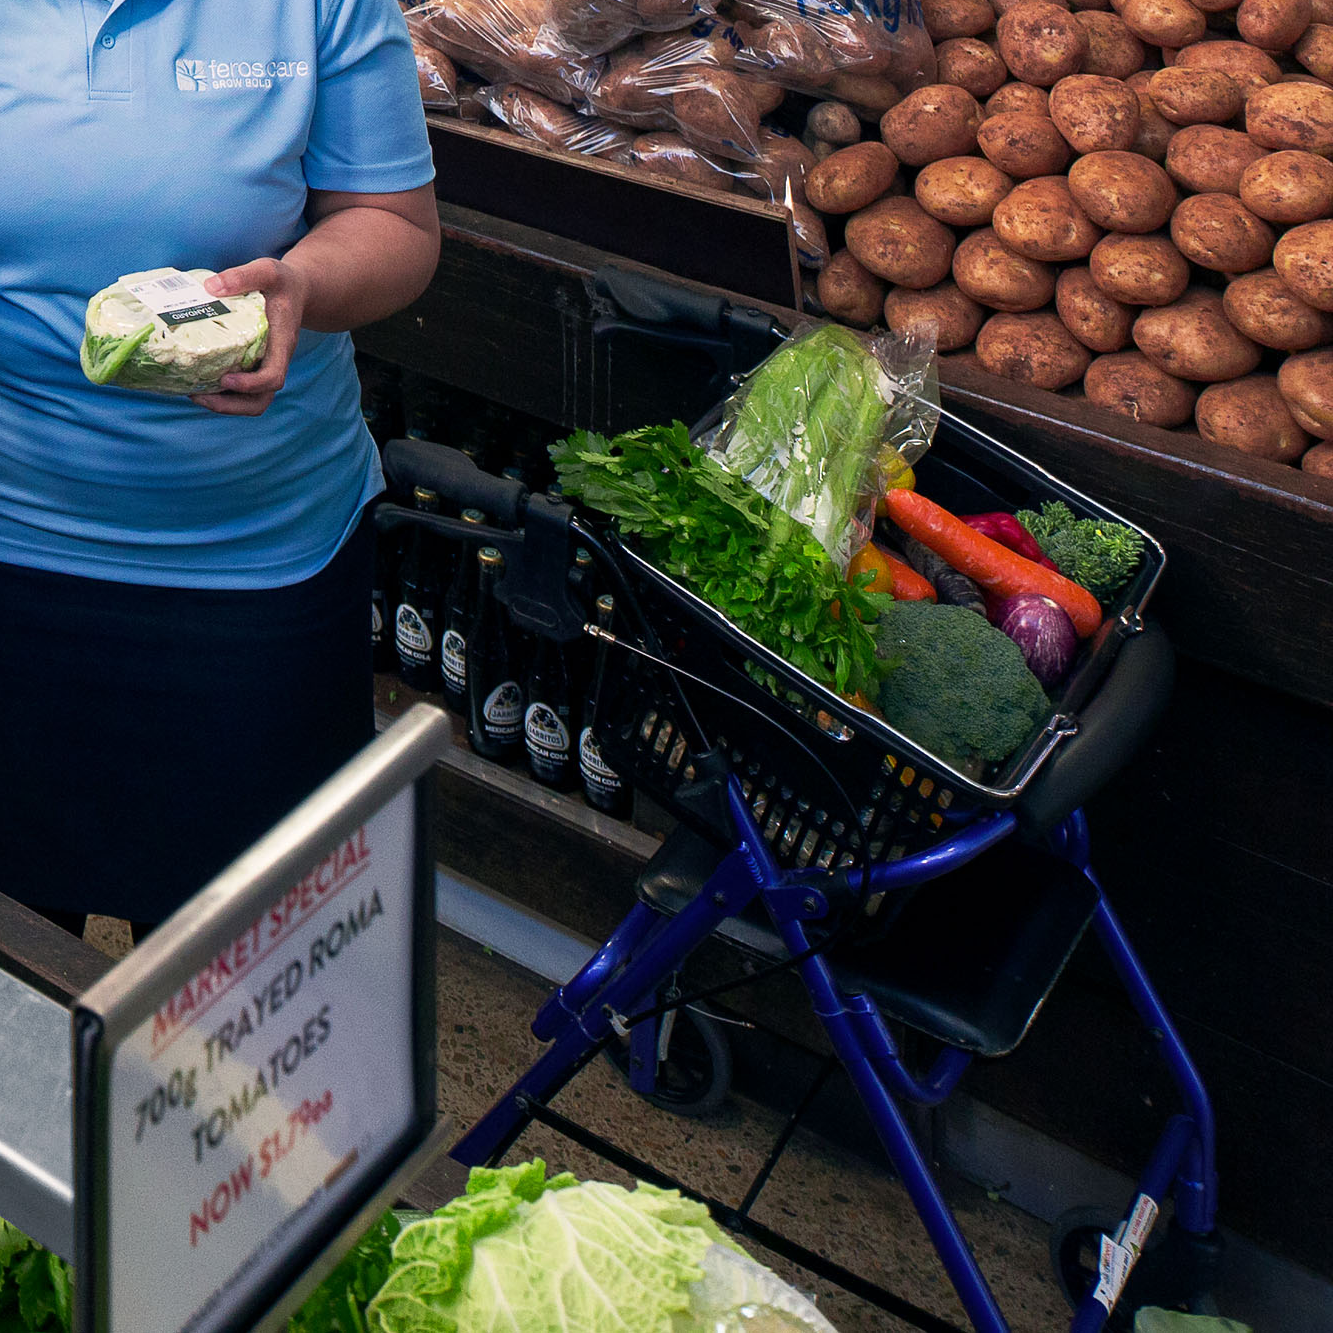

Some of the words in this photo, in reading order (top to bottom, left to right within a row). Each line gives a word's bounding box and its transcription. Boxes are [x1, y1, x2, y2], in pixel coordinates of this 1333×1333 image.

[208, 60, 264, 79] feros
[266, 61, 308, 77] care
[212, 79, 242, 89] GROW
[245, 79, 271, 88] BOLD
[172, 306, 214, 319] STANDARD
[529, 726, 561, 744] JARRITOS
[550, 752, 569, 761] COLA
[148, 916, 264, 1047] MARKET
[269, 824, 374, 938] SPECIAL
[132, 1068, 200, 1146] 700g
[202, 964, 304, 1071] TRAYED
[308, 888, 384, 977] ROMA
[190, 1004, 334, 1165] TOMATOES
[186, 1161, 256, 1248] NOW
